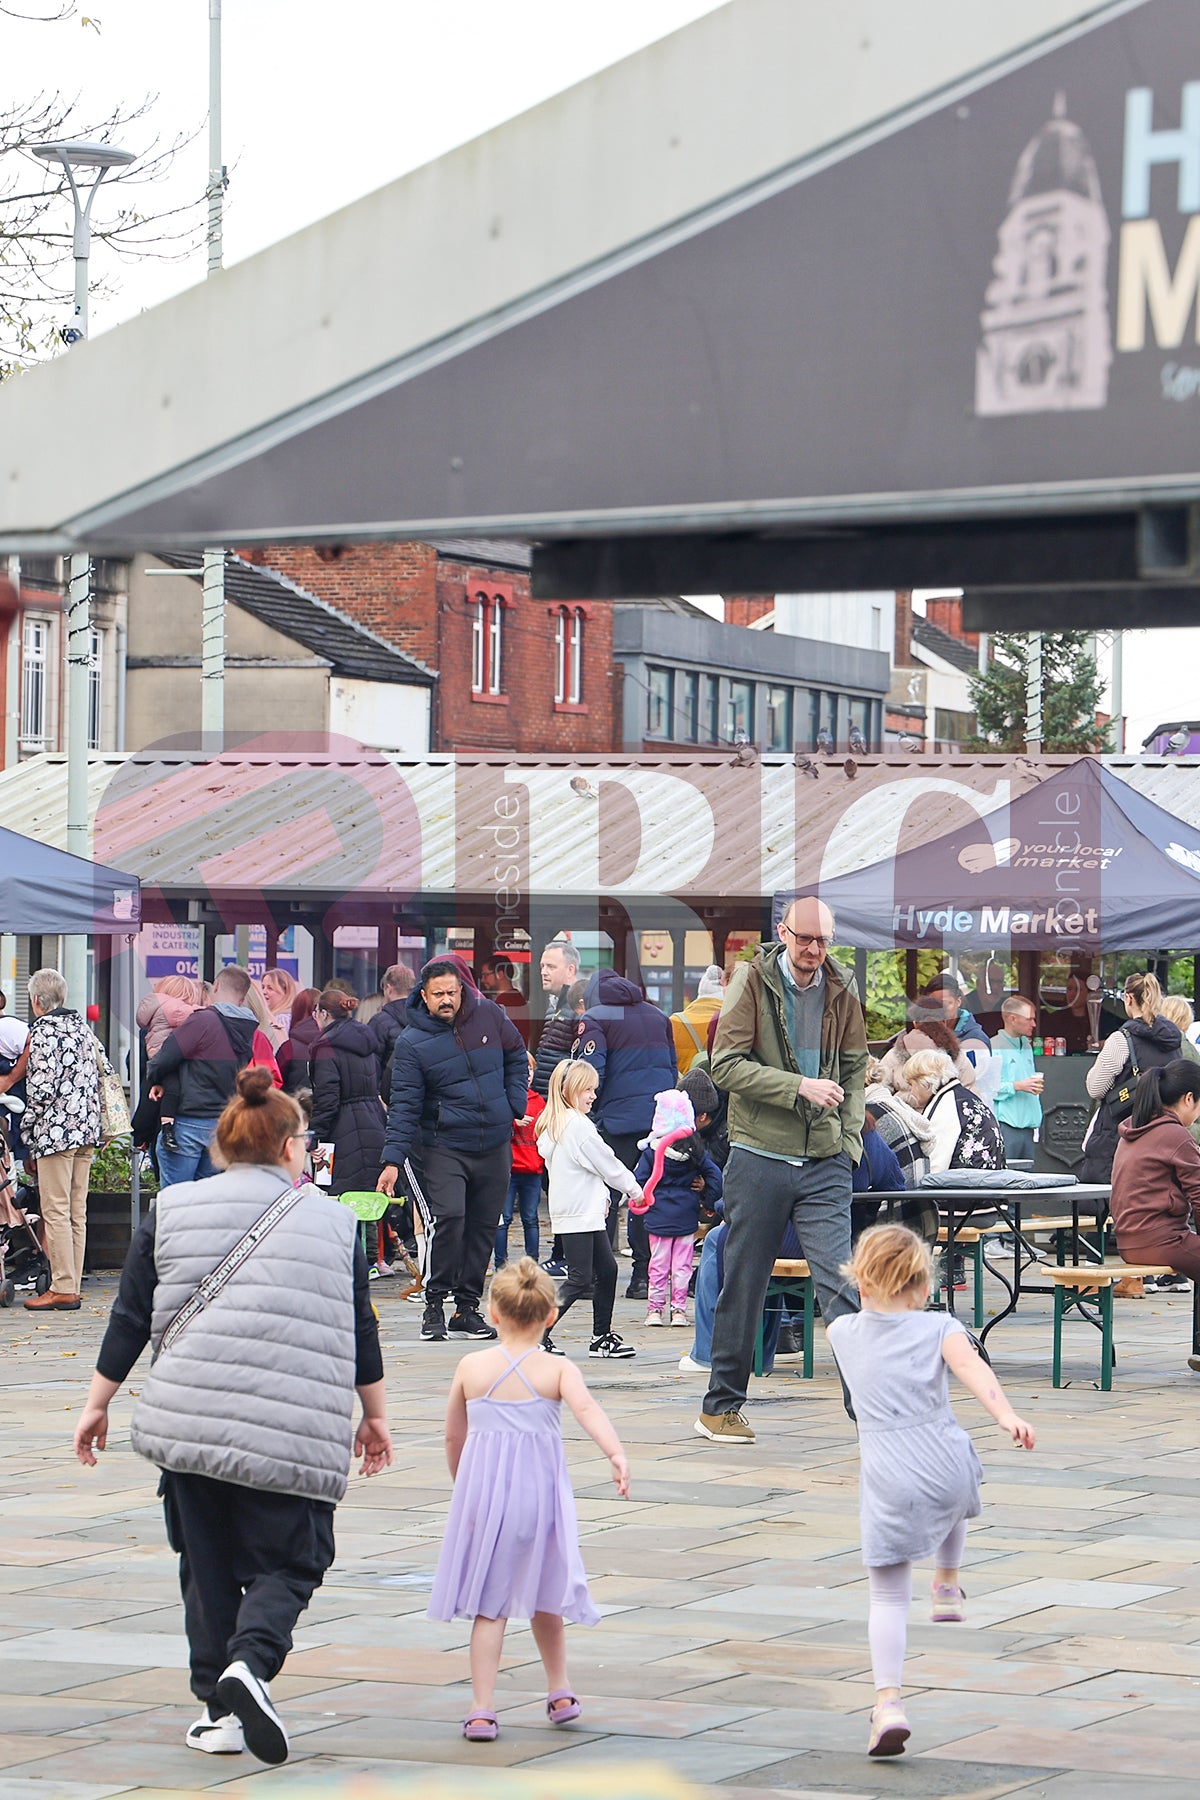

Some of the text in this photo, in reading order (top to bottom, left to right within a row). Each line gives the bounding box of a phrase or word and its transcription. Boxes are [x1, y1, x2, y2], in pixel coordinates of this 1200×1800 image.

[1022, 842, 1123, 858] your local
[1013, 856, 1112, 870] market
[893, 904, 1099, 939] Hyde Market
